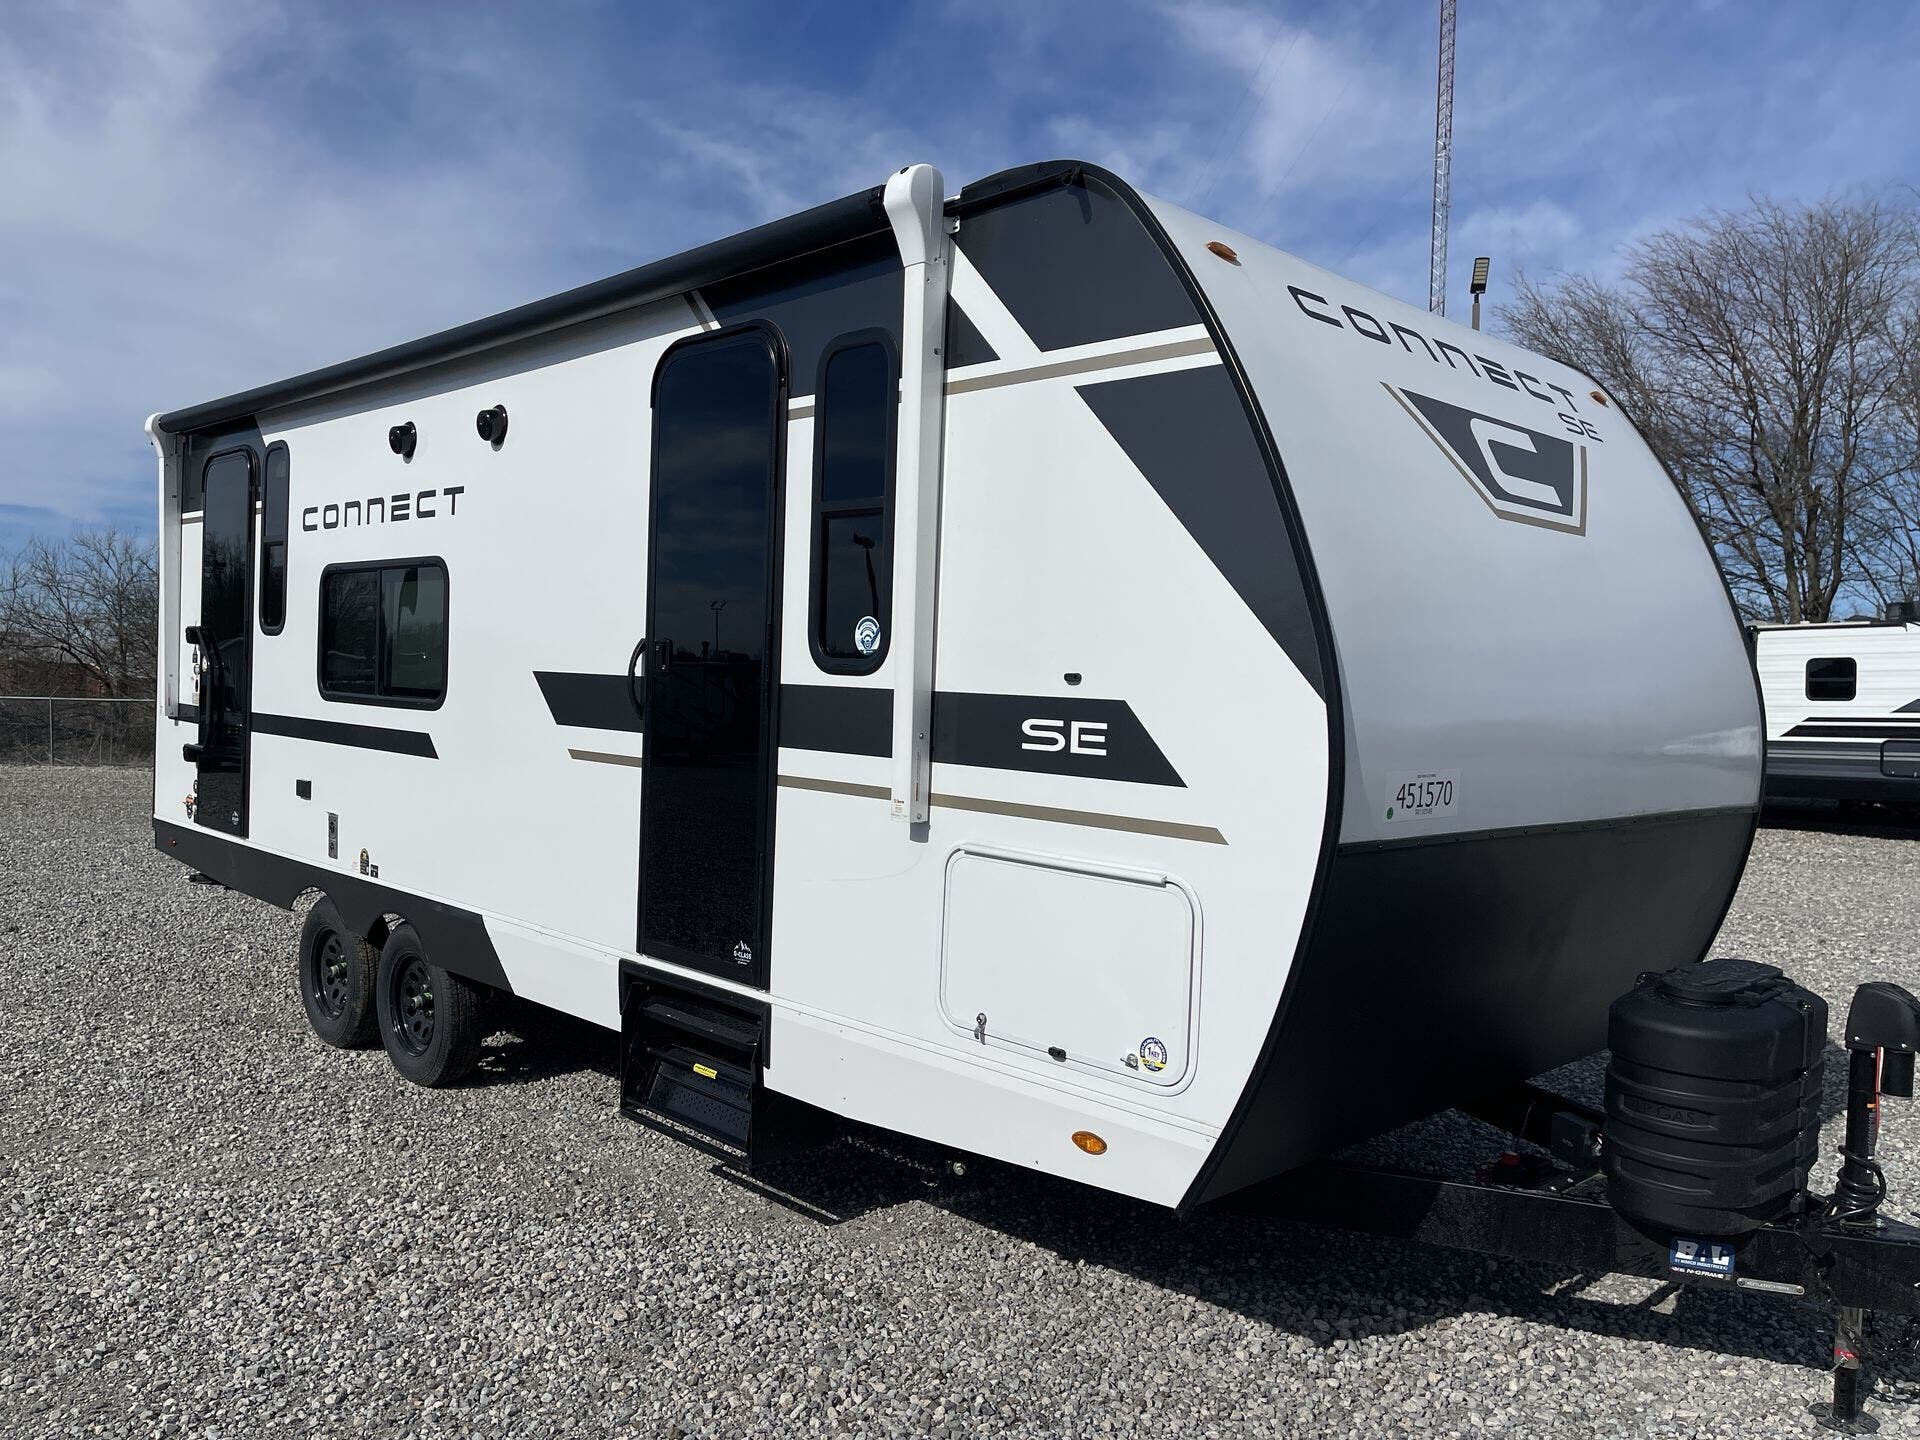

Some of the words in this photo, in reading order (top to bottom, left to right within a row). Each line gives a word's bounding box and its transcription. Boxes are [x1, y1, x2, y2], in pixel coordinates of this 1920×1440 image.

[1287, 285, 1582, 413] CONNECT
[1558, 411, 1604, 443] SE
[302, 486, 465, 532] CONNECT
[1021, 718, 1108, 757] SE
[1396, 780, 1453, 809] 451570
[1656, 1106, 1696, 1125] GAS
